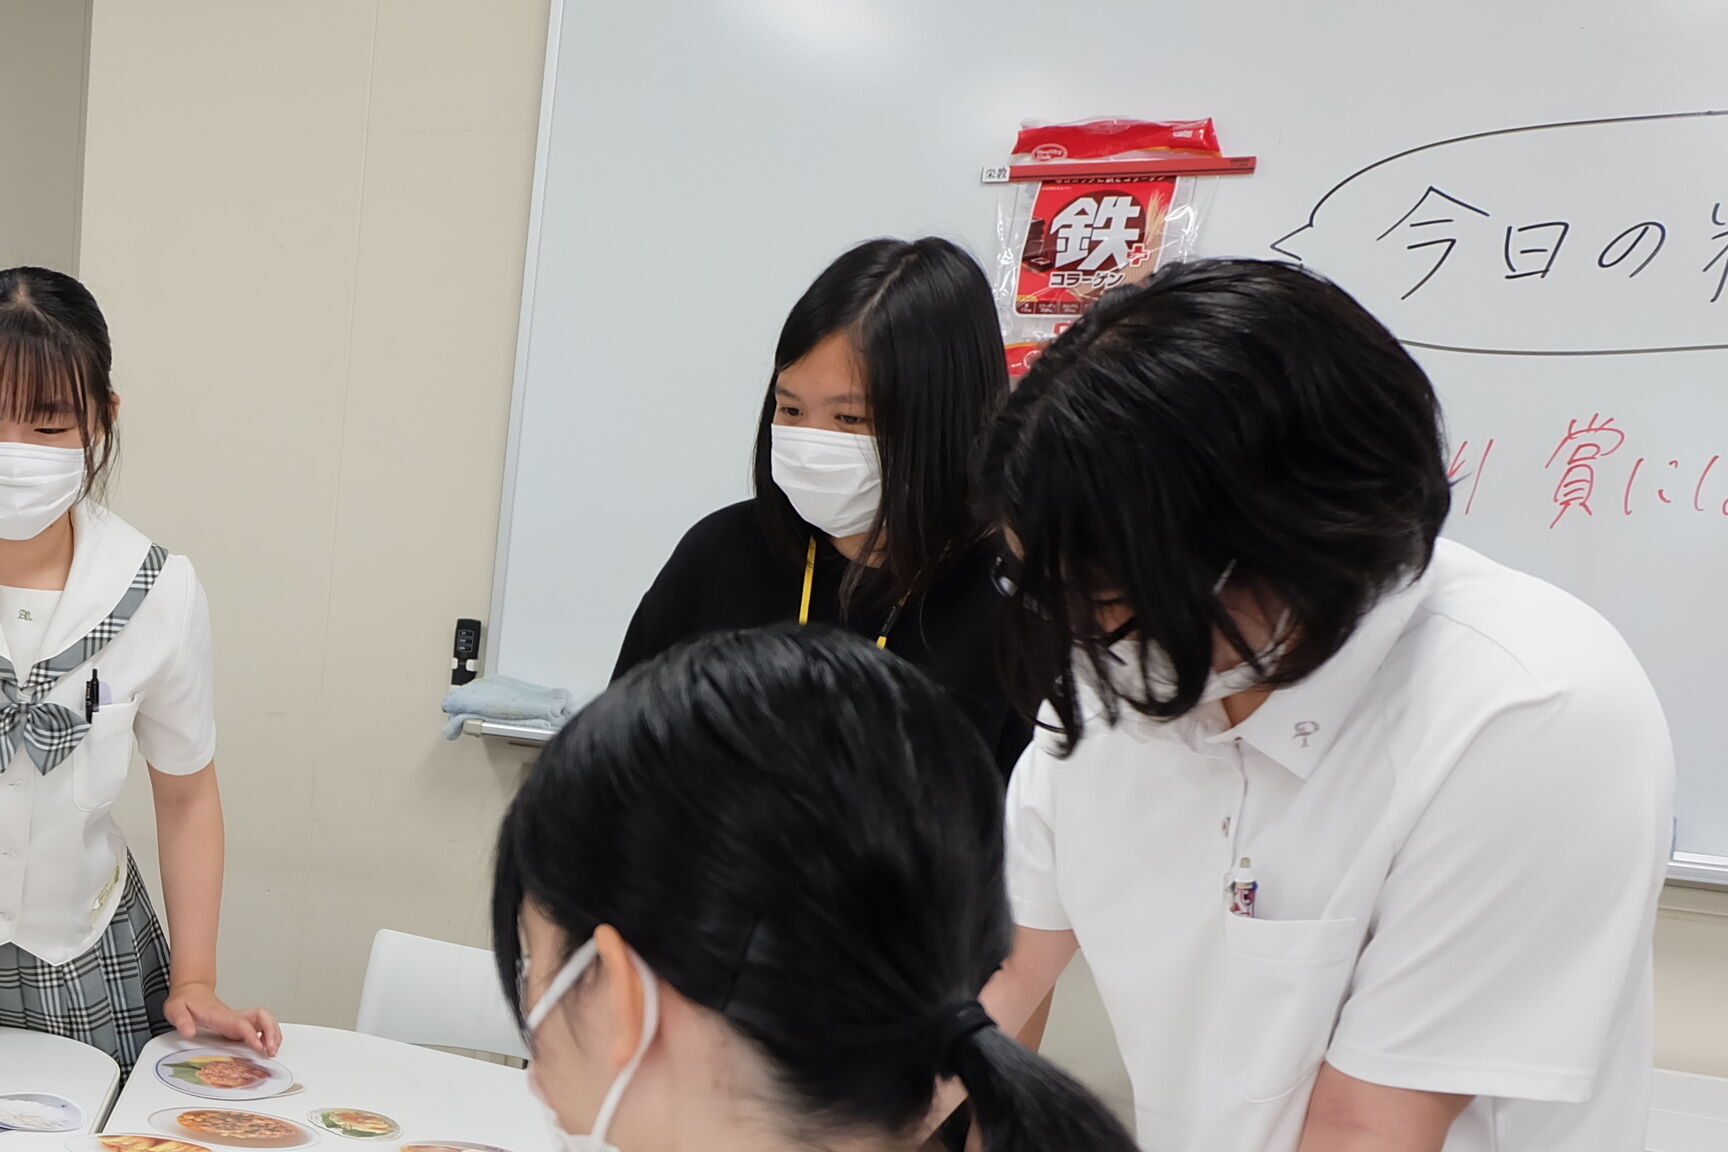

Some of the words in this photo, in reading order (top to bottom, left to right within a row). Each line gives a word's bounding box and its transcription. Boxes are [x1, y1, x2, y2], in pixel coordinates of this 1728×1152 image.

[1049, 195, 1141, 271] 鉄
[1050, 270, 1124, 289] コラーゲン
